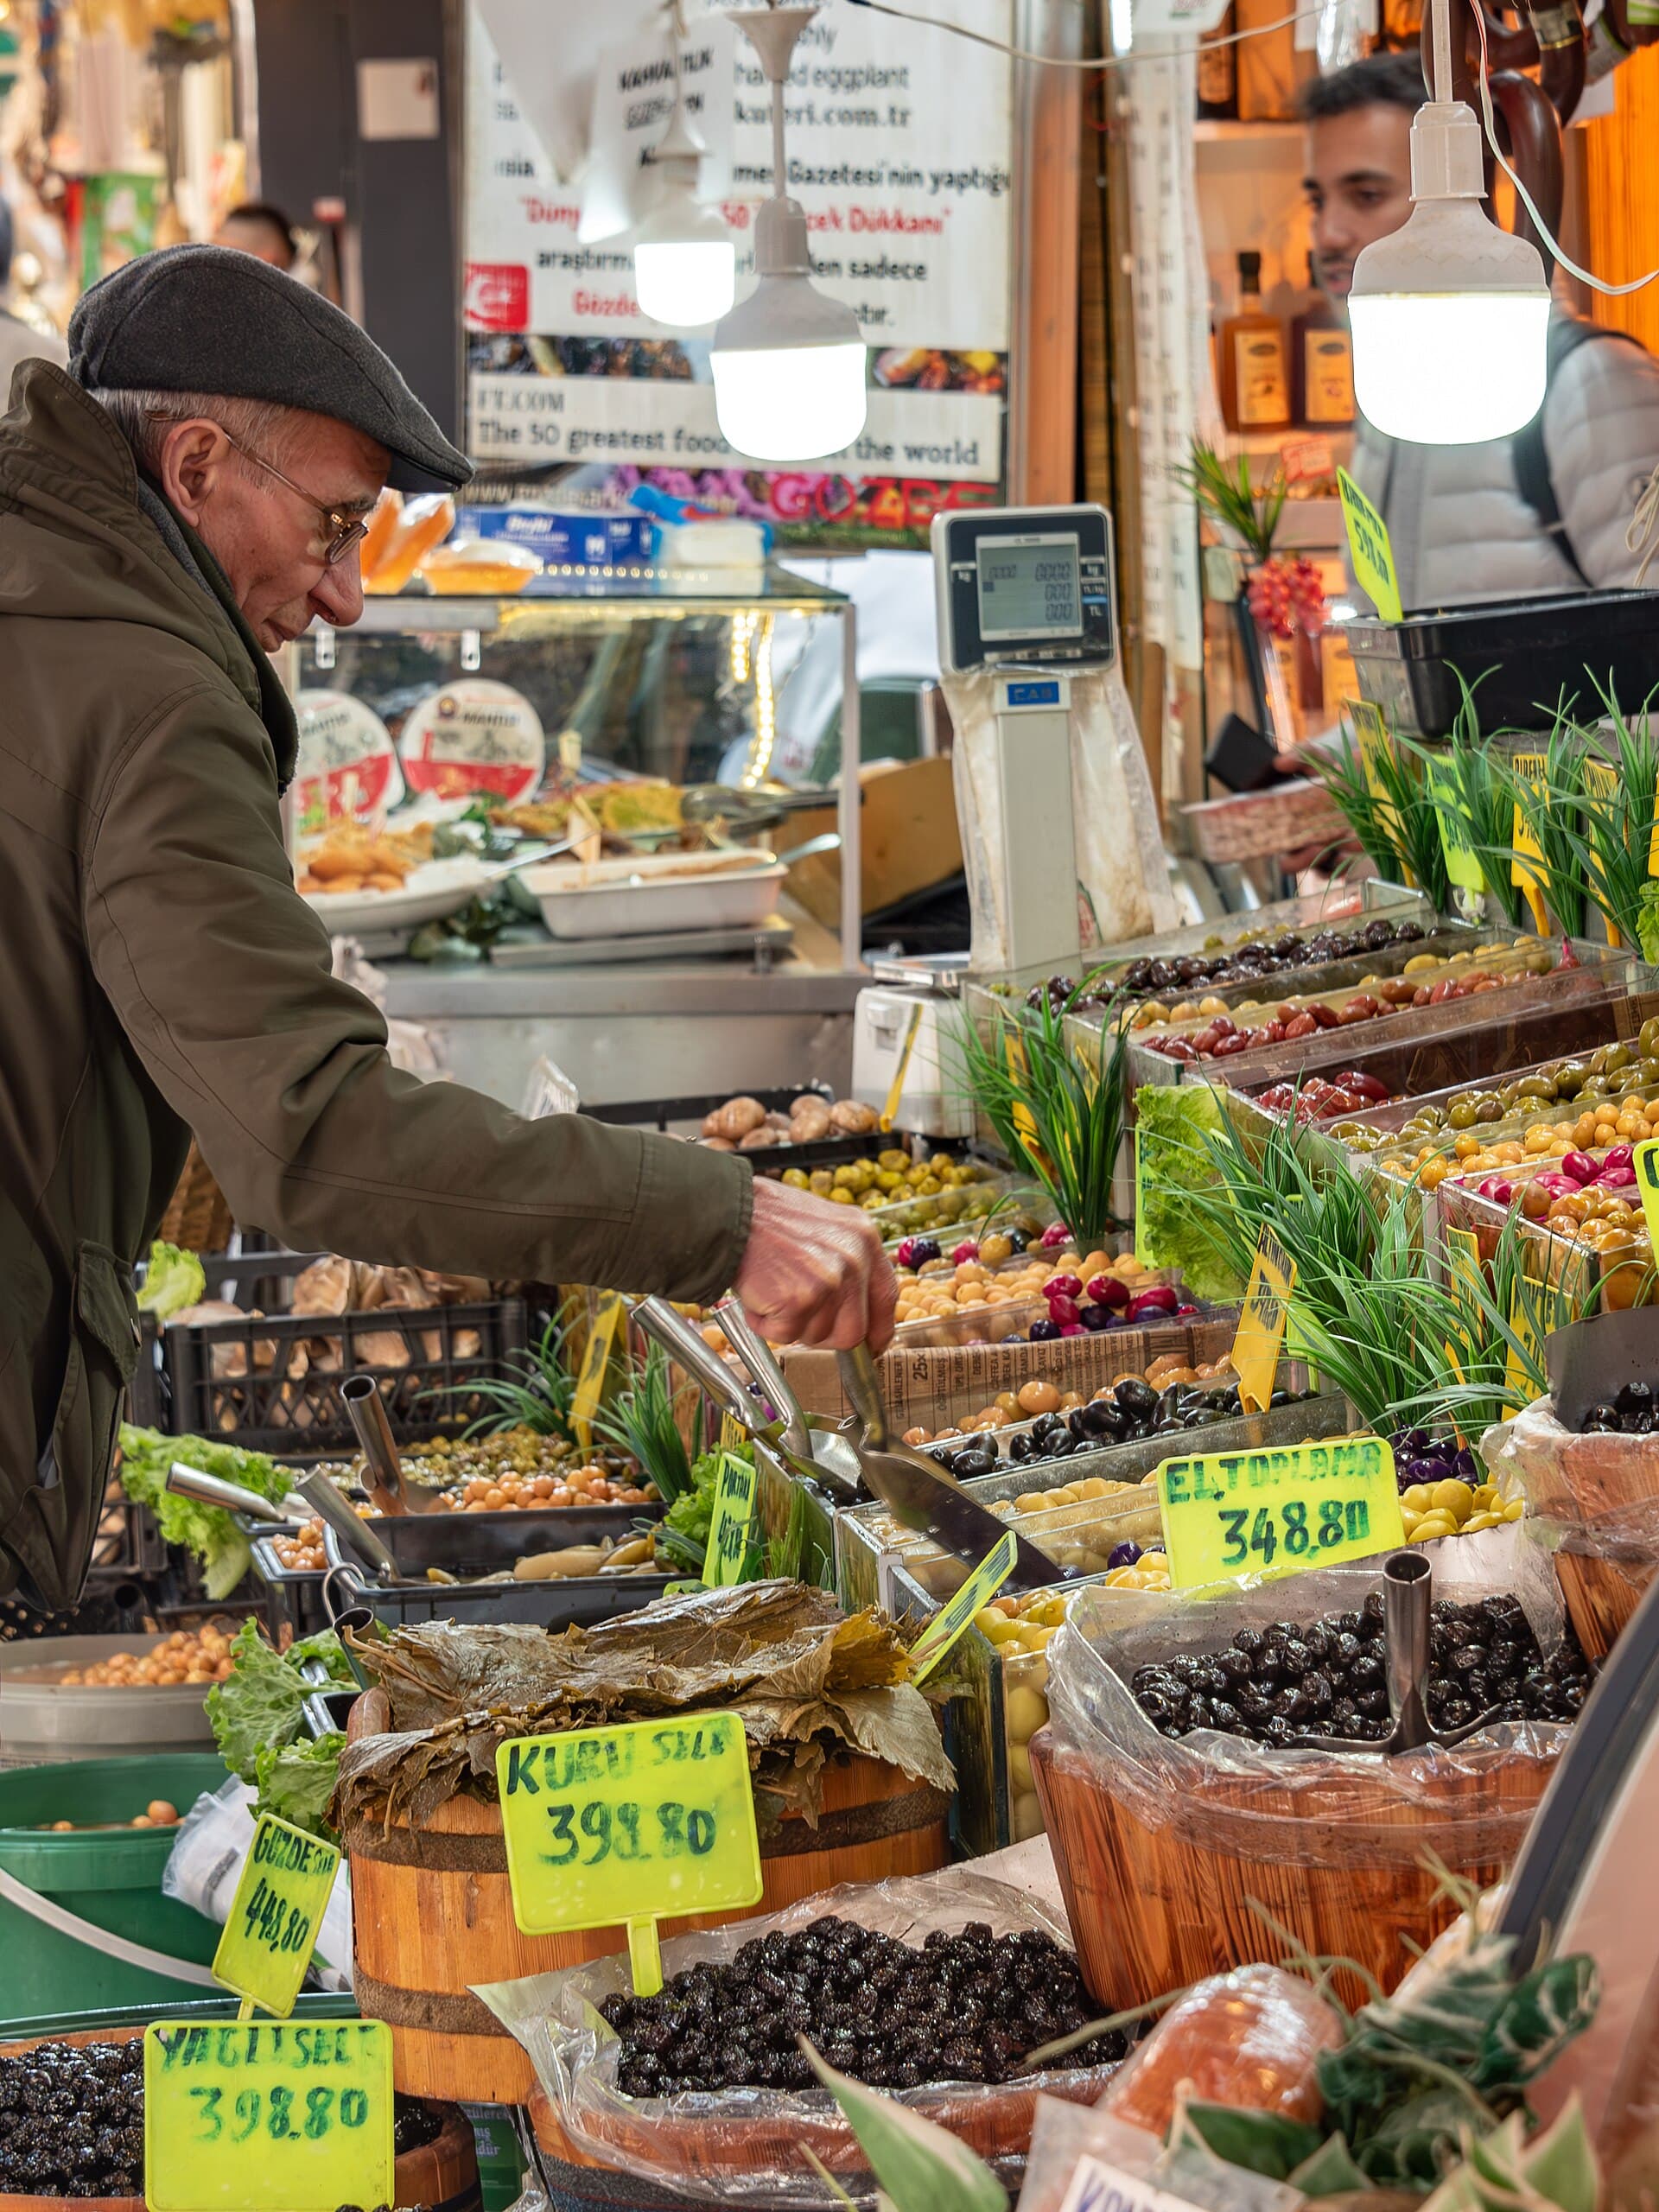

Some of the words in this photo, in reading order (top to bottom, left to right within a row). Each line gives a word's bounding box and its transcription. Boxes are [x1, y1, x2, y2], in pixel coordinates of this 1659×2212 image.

[849, 251, 928, 280] sadece
[480, 420, 523, 444] The
[529, 423, 561, 446] 50
[568, 428, 665, 455] greatest
[855, 437, 895, 462] the
[902, 440, 979, 467] world
[1218, 1499, 1370, 1566] 348,80
[506, 1732, 636, 1796] KURU
